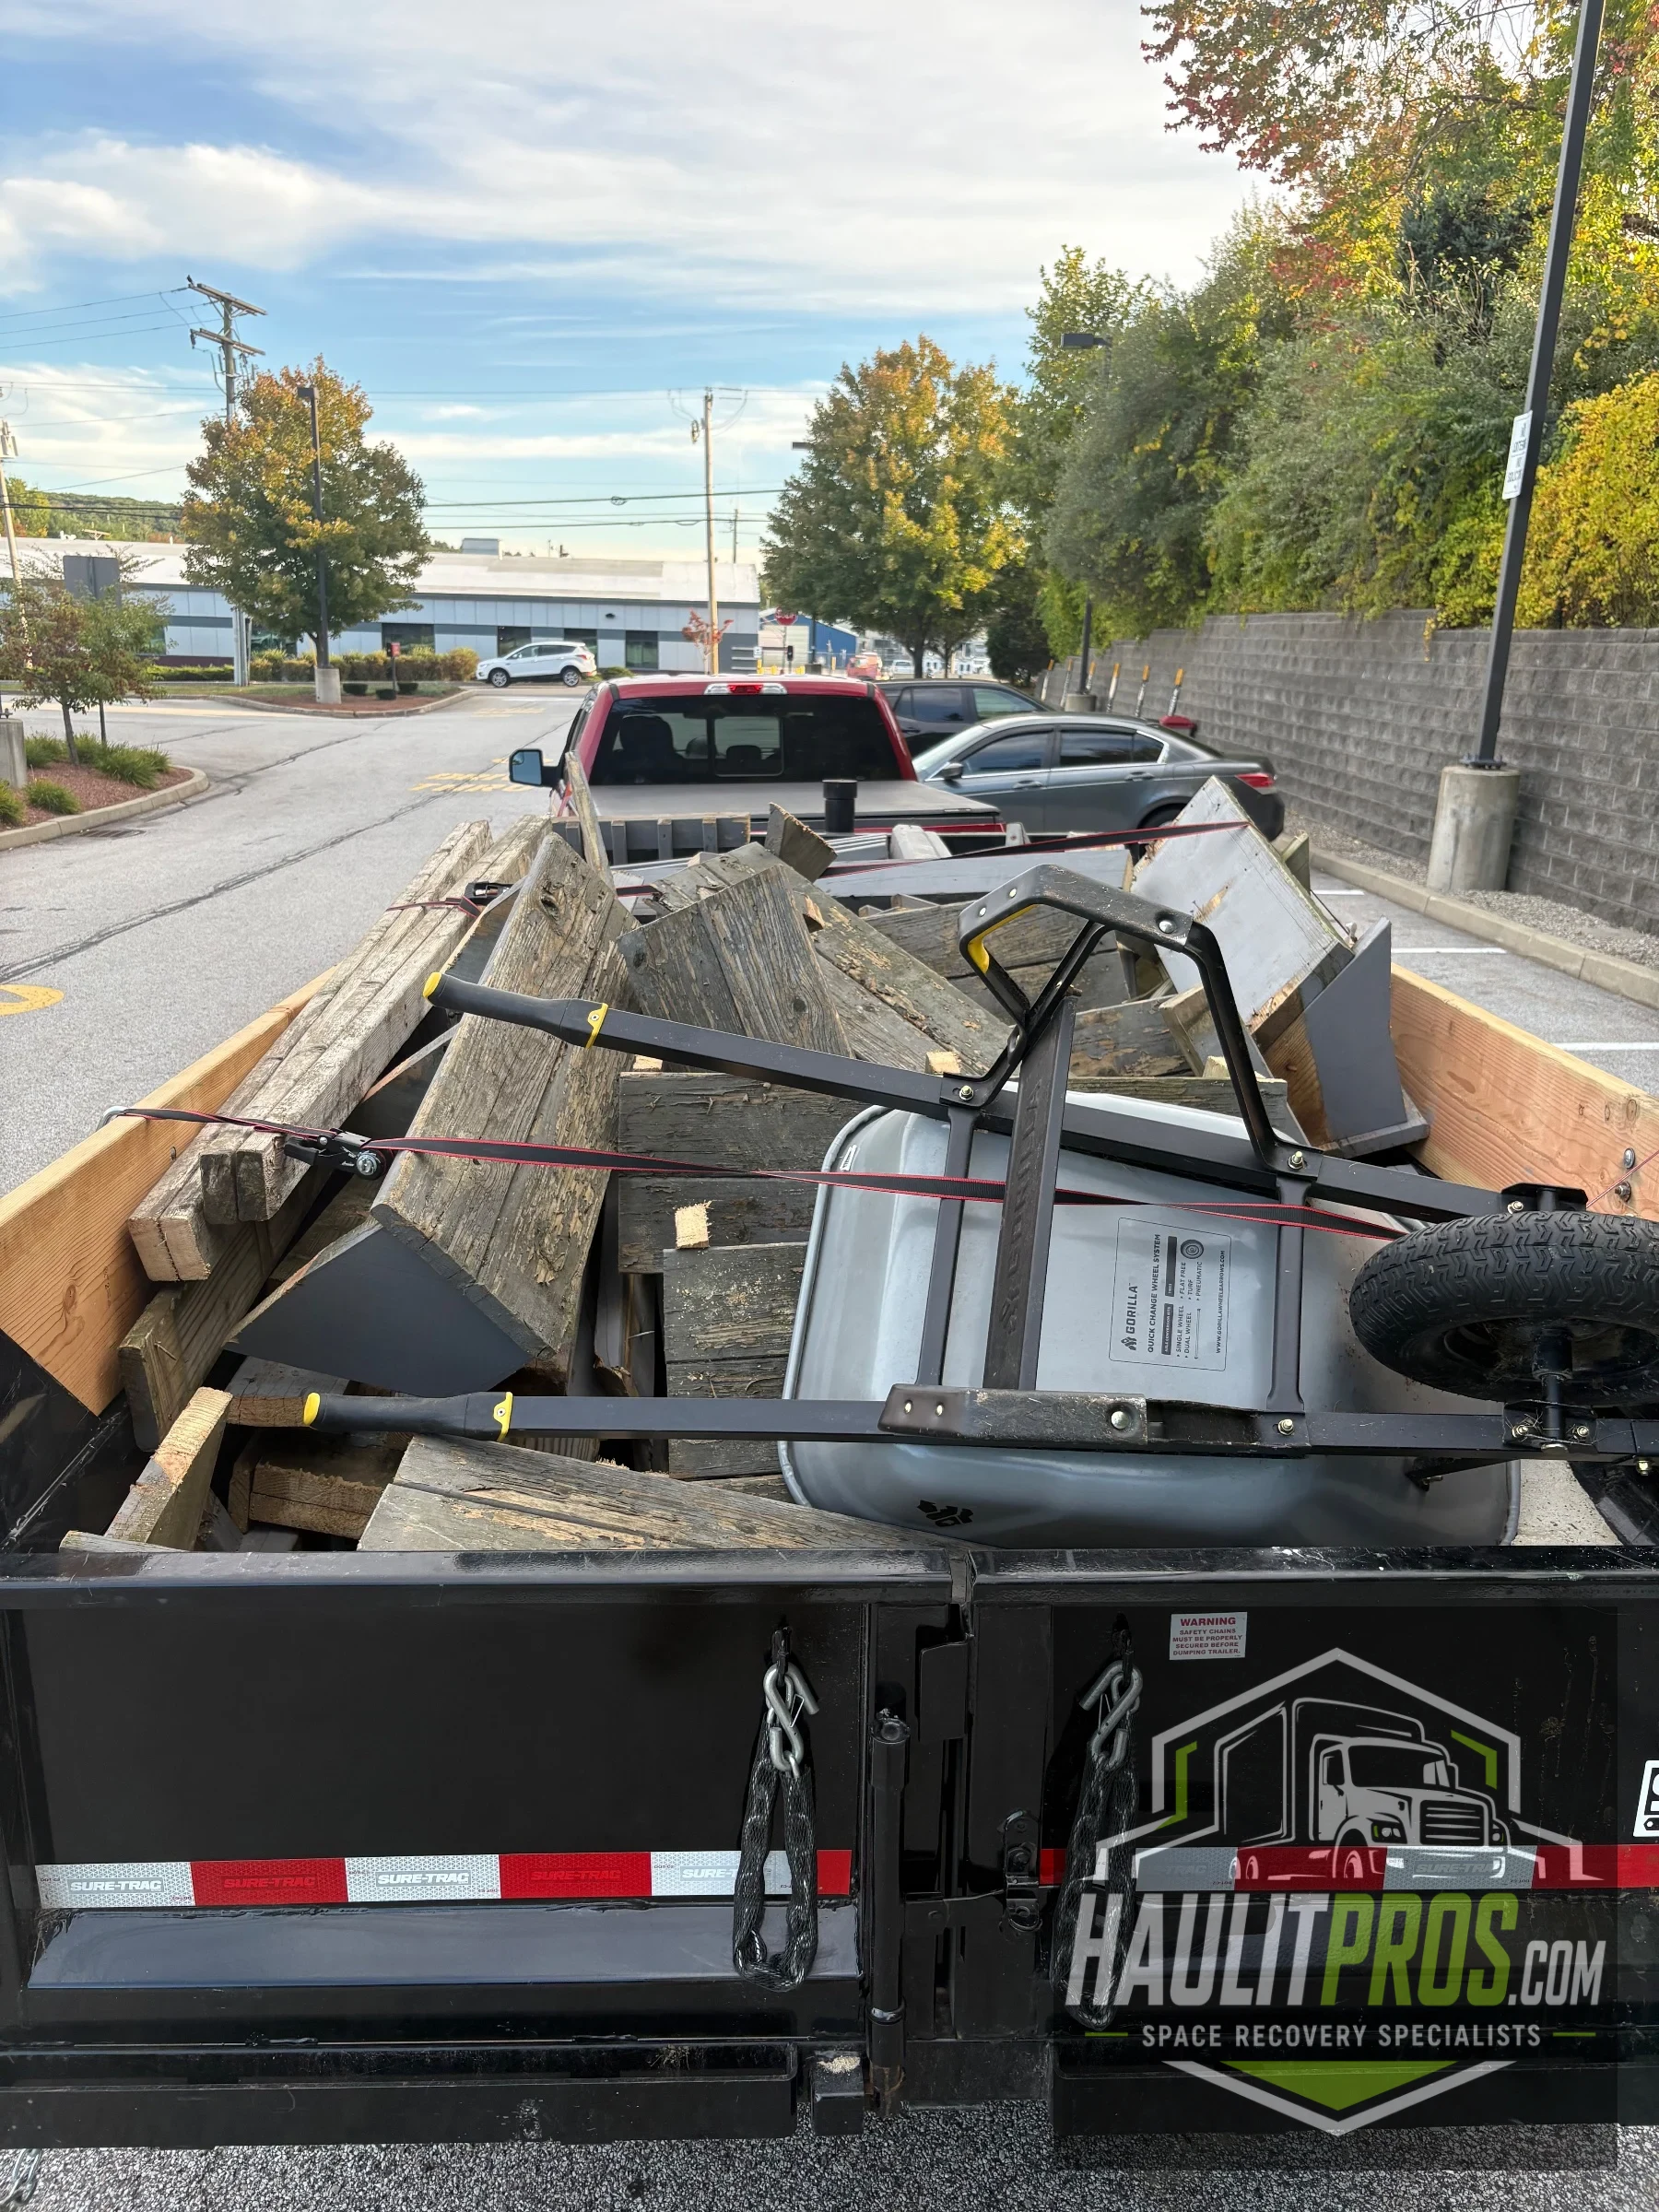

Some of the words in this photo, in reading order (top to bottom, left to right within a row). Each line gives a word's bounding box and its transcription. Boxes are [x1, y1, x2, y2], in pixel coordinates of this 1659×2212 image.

[1151, 1265, 1159, 1290] WHEEL
[1126, 1286, 1138, 1335] GORILLA
[1149, 1293, 1158, 1325] CHANGE
[1180, 1617, 1236, 1627] WARNING
[378, 1873, 470, 1885] SURE-TRAC
[530, 1869, 622, 1881] SURE-TRAC
[682, 1868, 738, 1879] SURE-T
[70, 1880, 162, 1892] SURE-TRAC
[224, 1877, 316, 1888] SURE-TRAC
